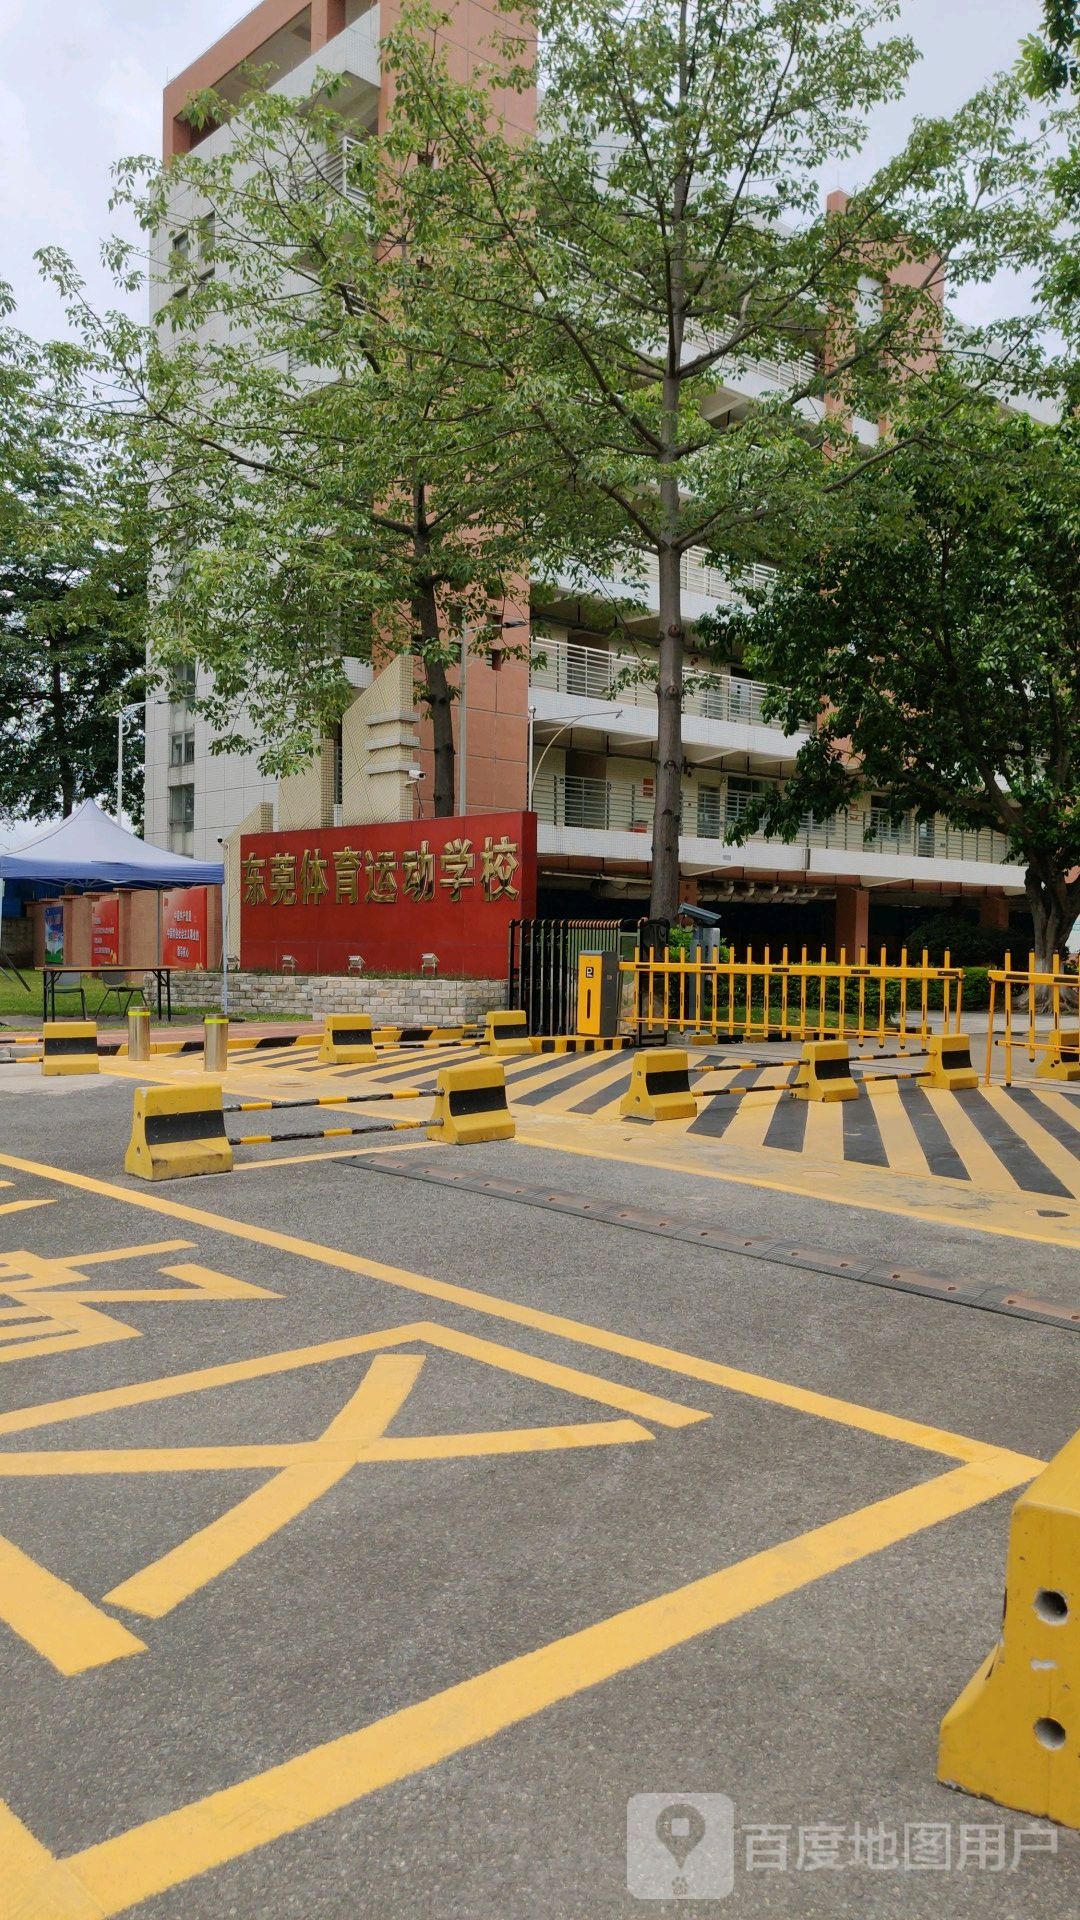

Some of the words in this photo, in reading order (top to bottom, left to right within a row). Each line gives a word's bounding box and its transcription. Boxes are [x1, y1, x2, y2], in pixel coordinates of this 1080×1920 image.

[241, 836, 519, 905] 东莞体育运动学校
